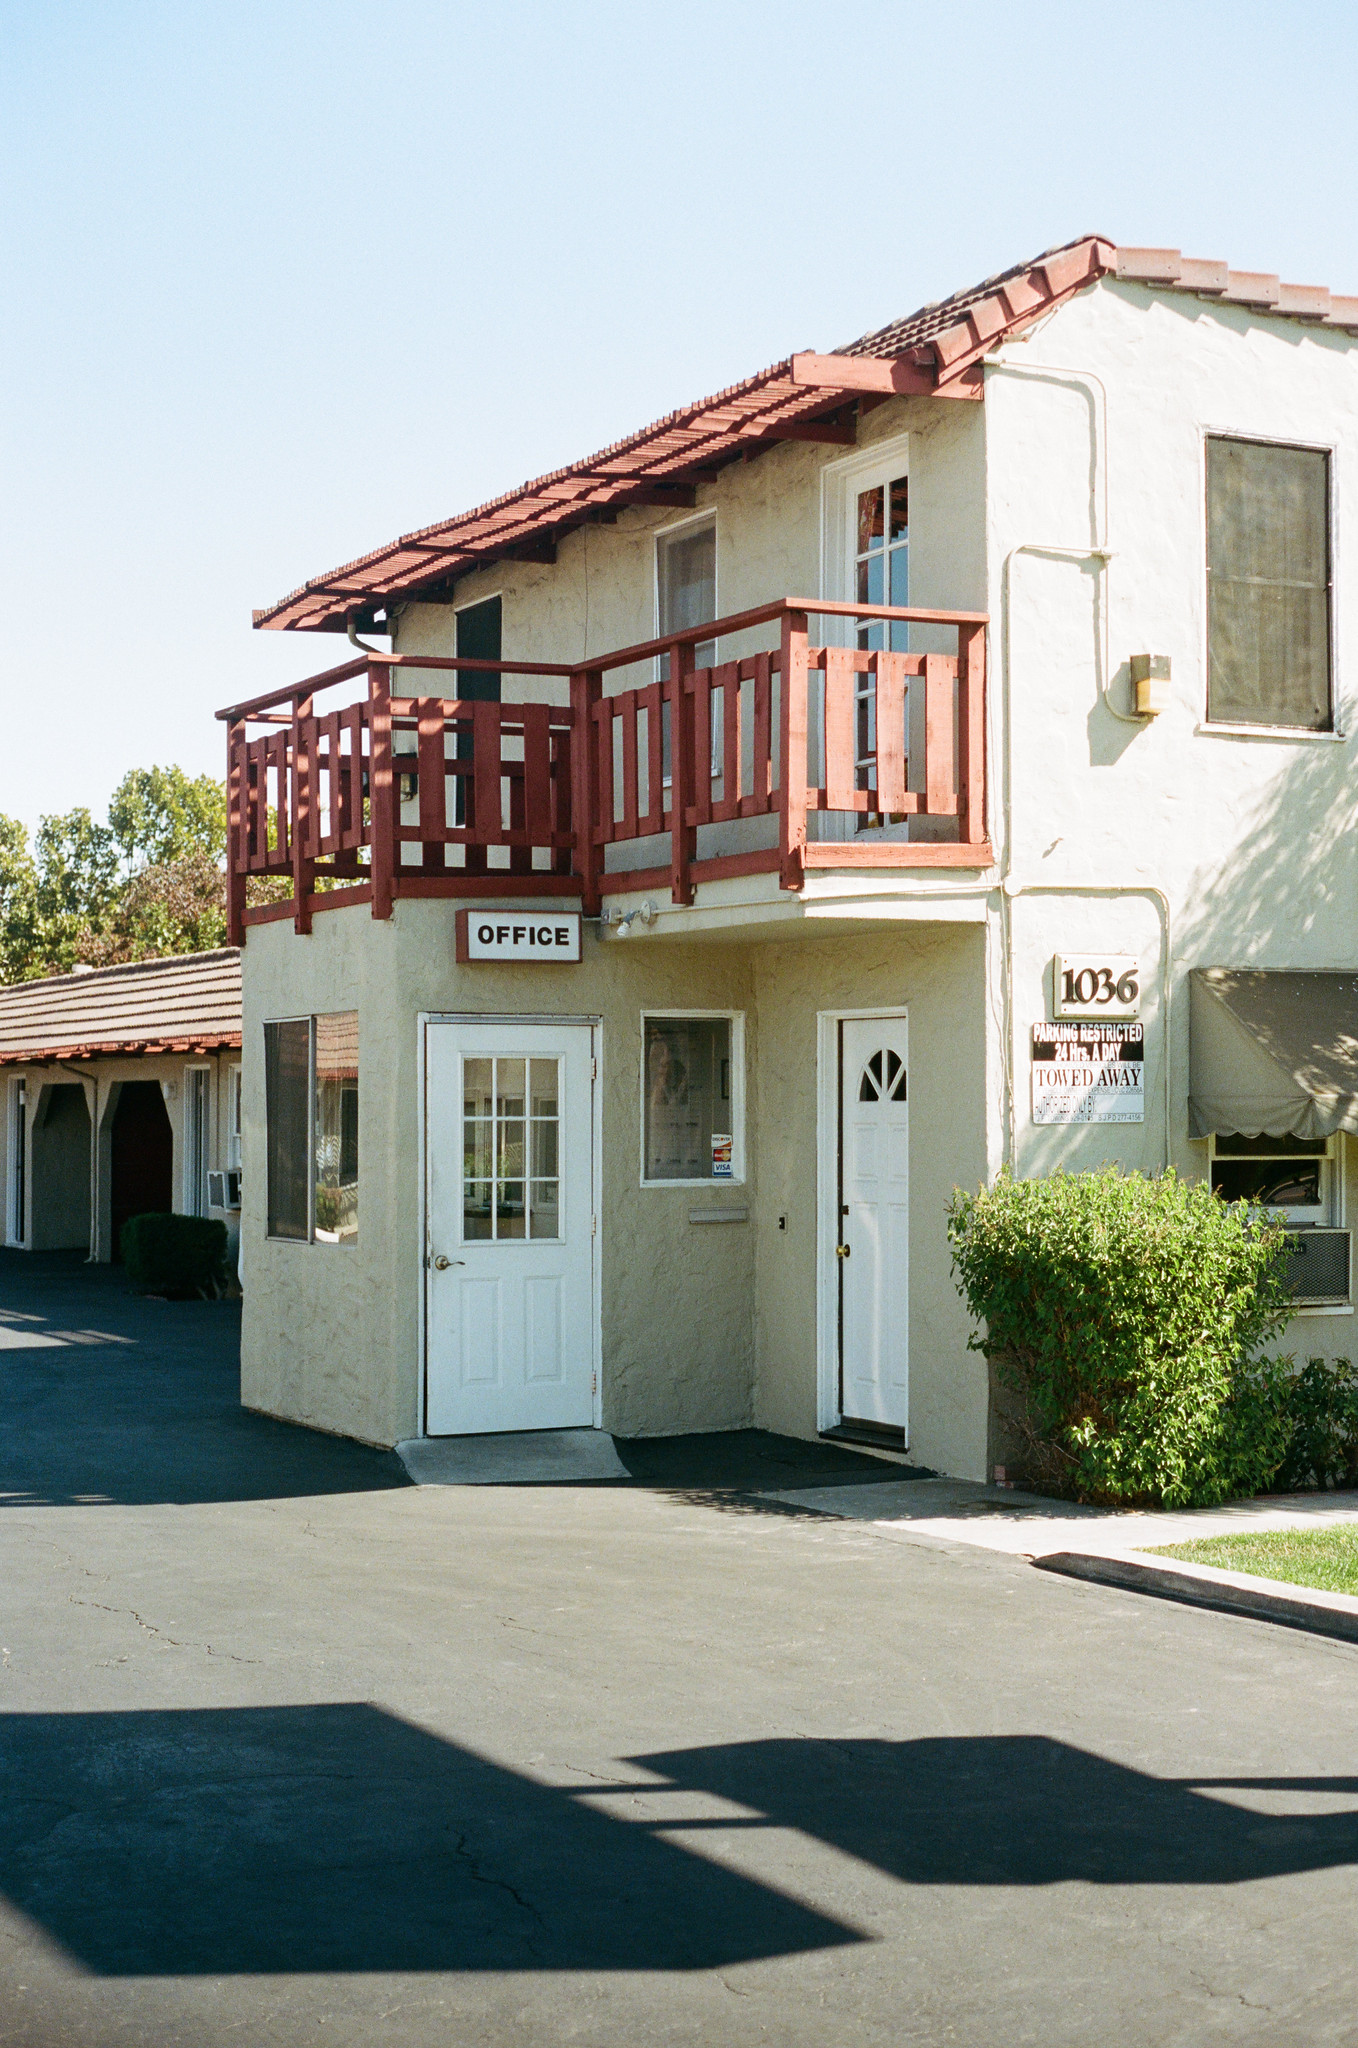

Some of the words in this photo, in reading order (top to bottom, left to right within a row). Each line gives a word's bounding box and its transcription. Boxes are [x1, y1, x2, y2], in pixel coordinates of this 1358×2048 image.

[478, 925, 569, 945] OFFICE
[1062, 968, 1139, 1004] 1036
[1033, 1023, 1078, 1042] PARKING
[1080, 1023, 1142, 1042] RESTRICTED
[1055, 1043, 1068, 1061] 24
[1092, 1043, 1101, 1061] A
[1102, 1043, 1122, 1061] DAY
[1036, 1069, 1093, 1087] TOWED
[1097, 1068, 1141, 1086] AWAY
[1073, 1096, 1087, 1114] ONLY
